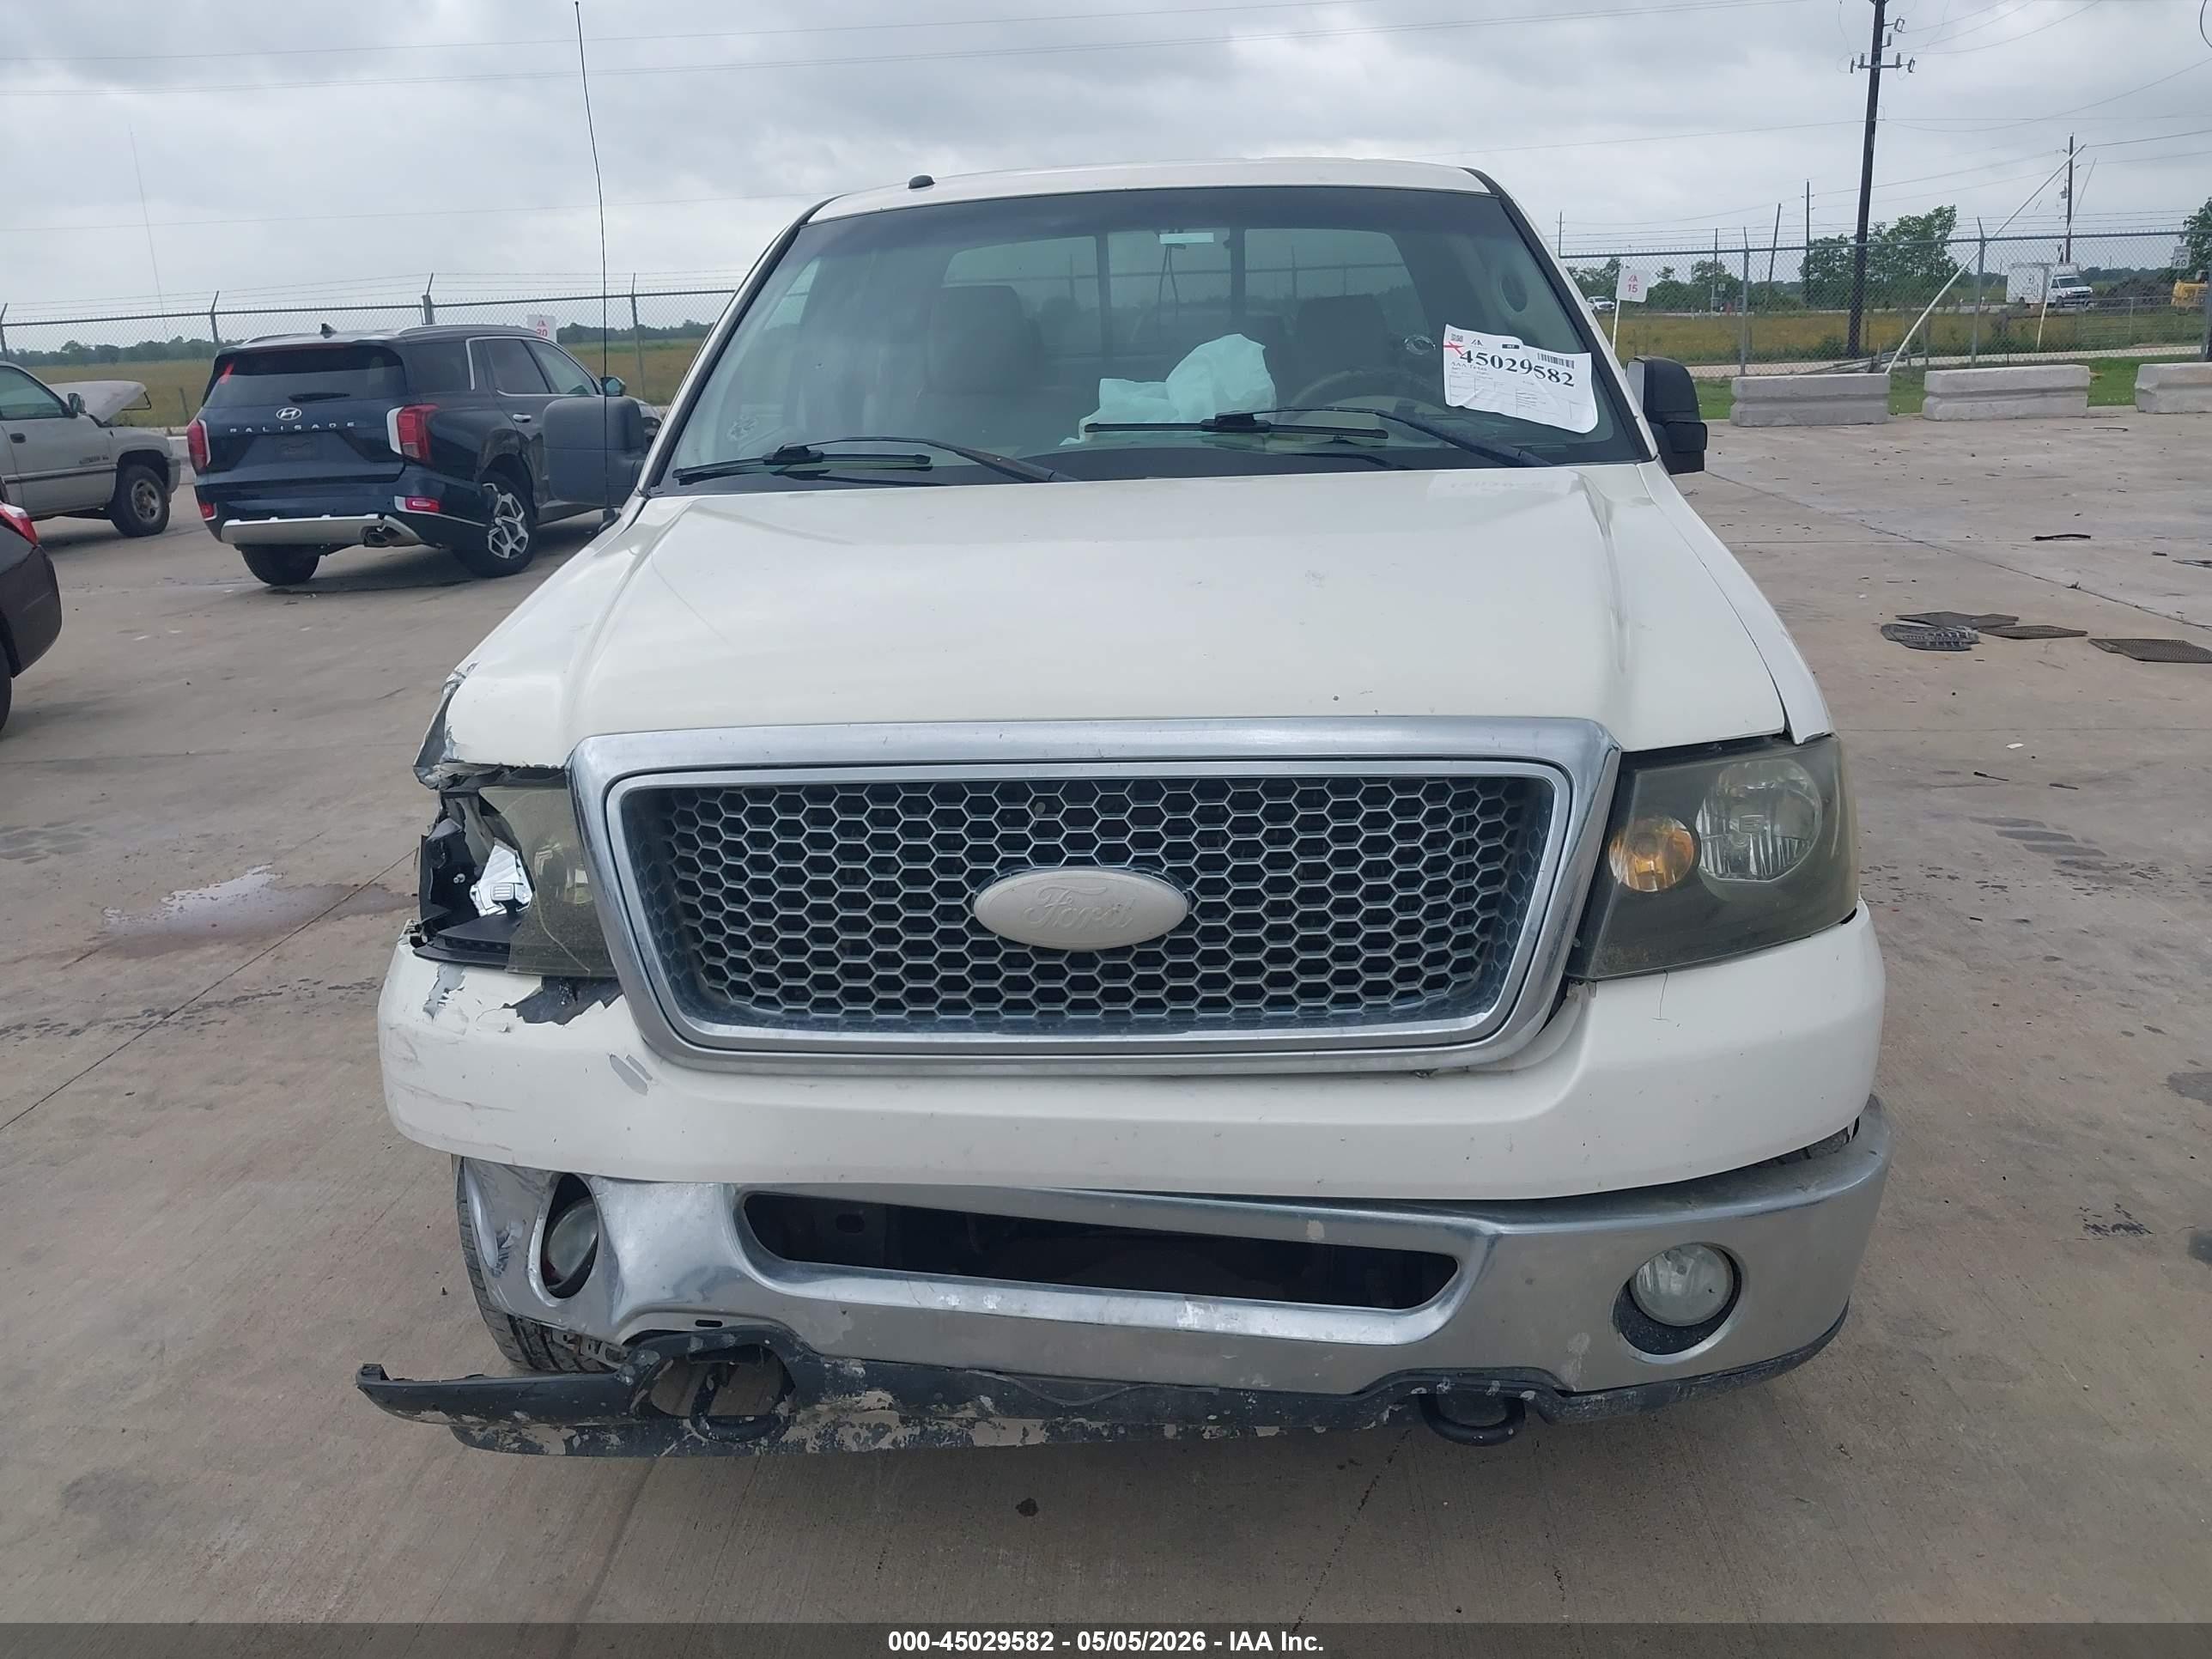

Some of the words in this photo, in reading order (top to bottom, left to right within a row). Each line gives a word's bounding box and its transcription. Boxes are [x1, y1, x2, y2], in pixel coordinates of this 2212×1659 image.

[1627, 284, 1638, 293] 15
[1460, 349, 1575, 387] 45029582
[230, 421, 355, 433] PALISADE
[1024, 884, 1135, 929] Ford
